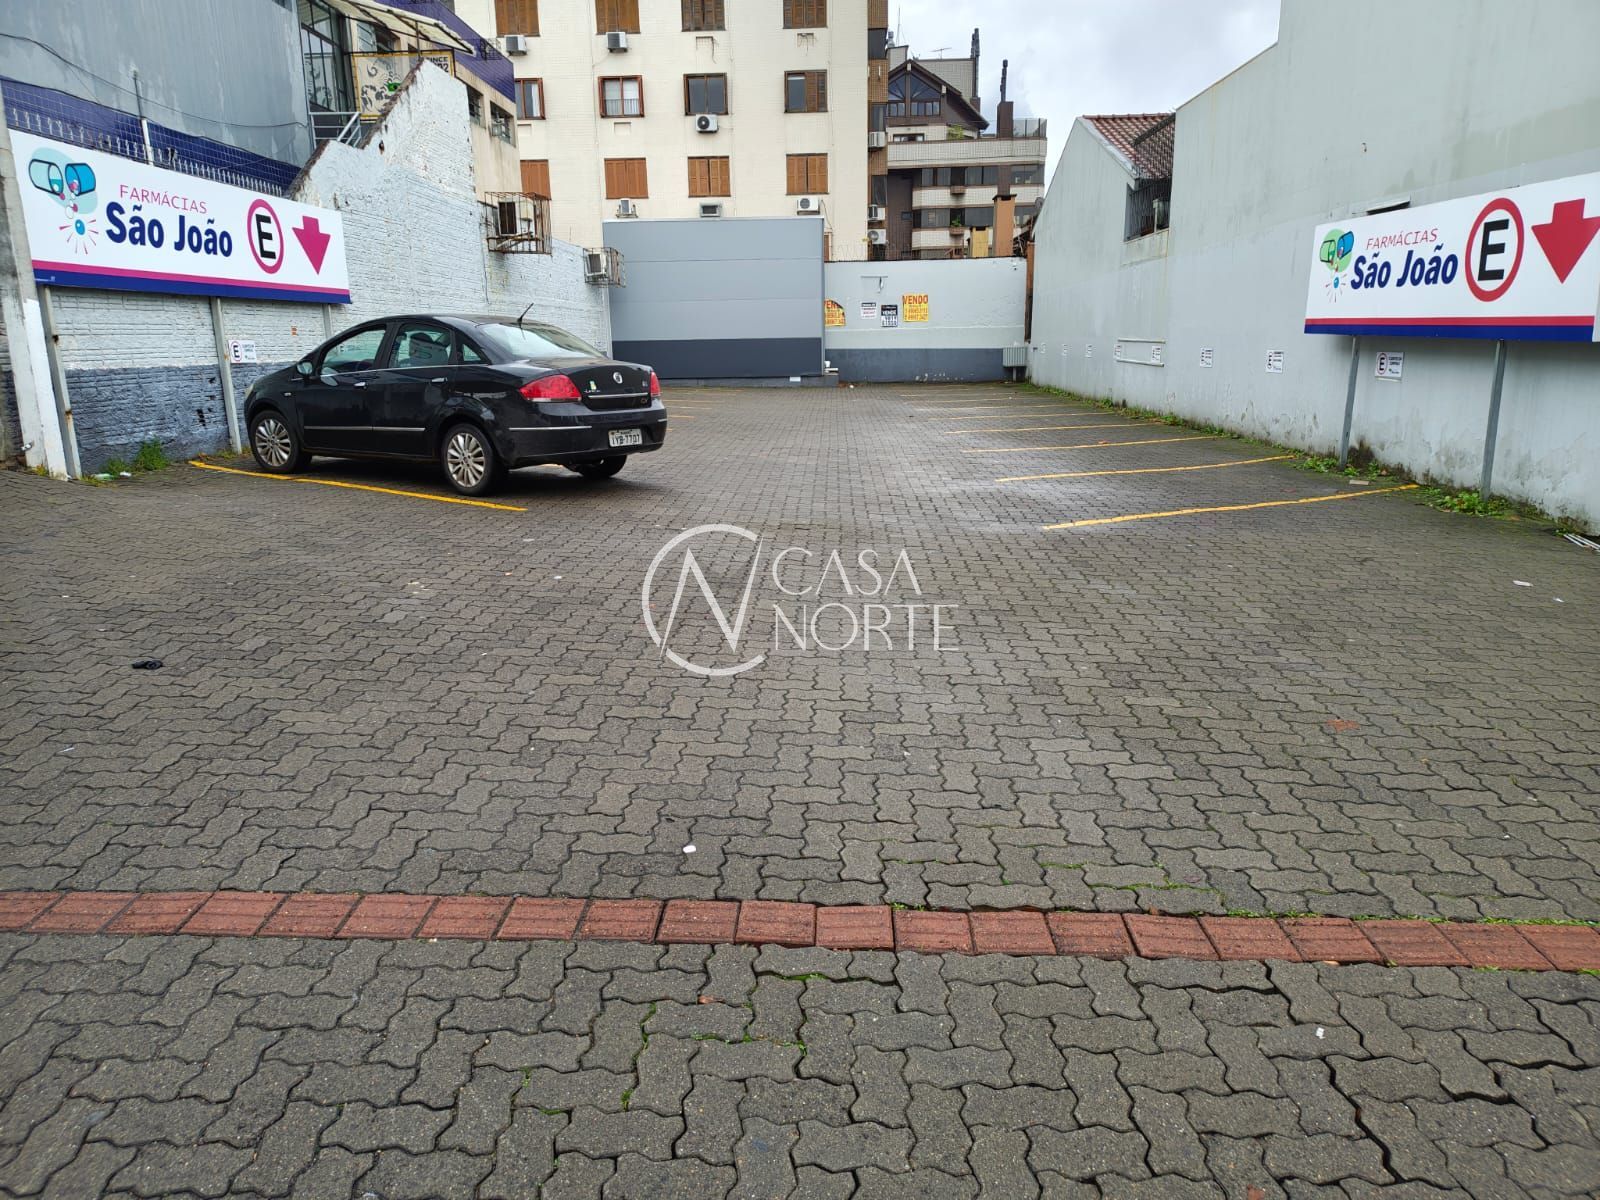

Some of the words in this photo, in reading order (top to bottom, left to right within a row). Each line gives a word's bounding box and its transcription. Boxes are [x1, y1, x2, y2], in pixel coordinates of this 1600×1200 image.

[119, 184, 208, 214] FARMÁCIAS
[105, 201, 165, 249] São
[173, 214, 234, 258] João
[255, 213, 277, 259] E
[1365, 228, 1439, 251] FARMÁCIAS
[1477, 218, 1510, 282] E
[1350, 252, 1392, 290] São
[1396, 243, 1459, 288] João
[902, 294, 928, 305] VENDO
[233, 344, 240, 358] E
[1379, 356, 1386, 371] E
